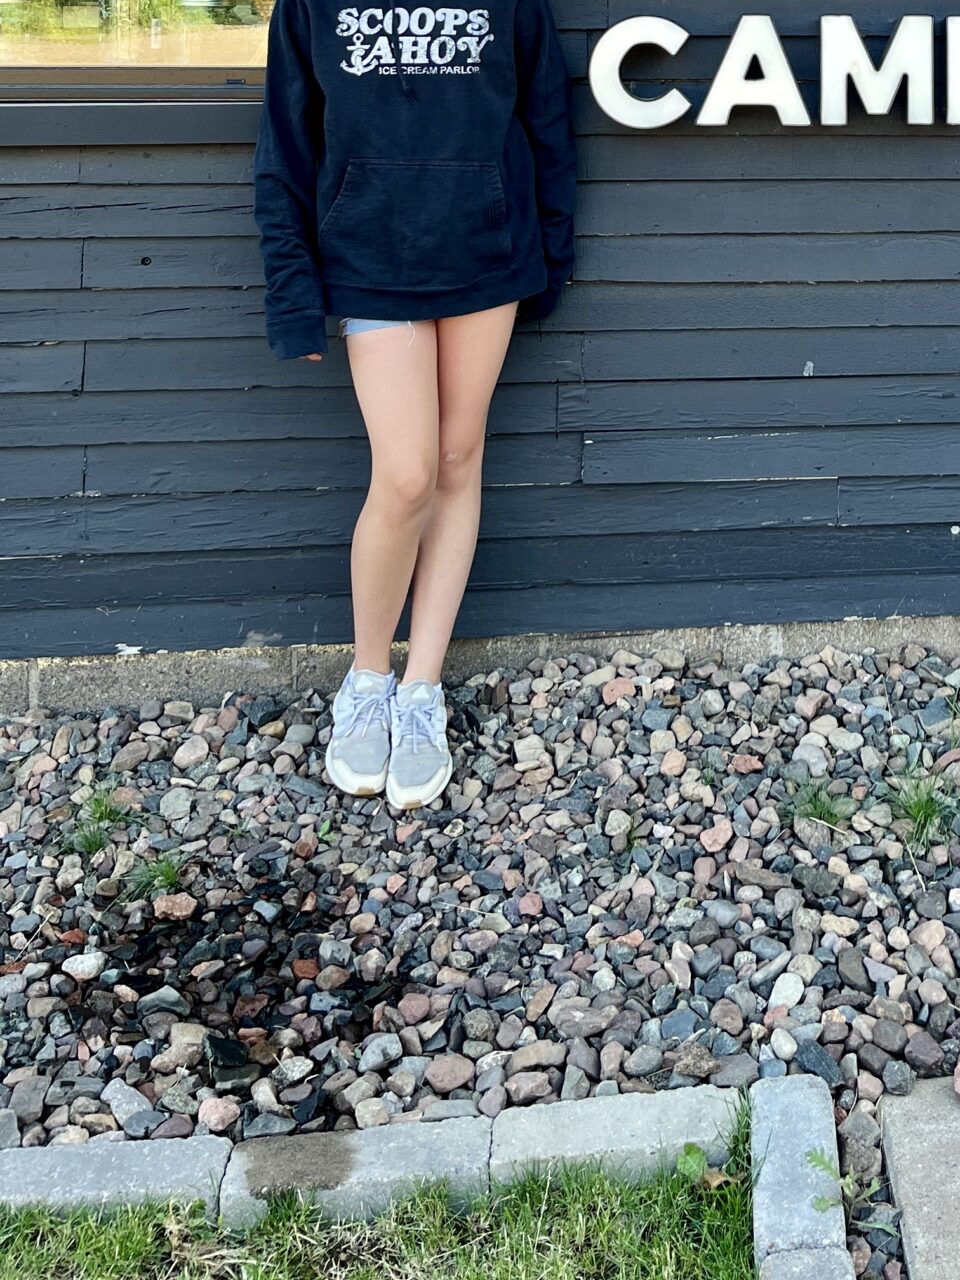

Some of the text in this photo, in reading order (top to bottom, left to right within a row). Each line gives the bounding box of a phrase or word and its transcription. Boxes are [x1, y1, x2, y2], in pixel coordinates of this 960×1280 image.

[335, 7, 490, 36] SCOOPS
[363, 34, 495, 65] AHOY
[378, 66, 398, 75] ICE
[440, 66, 480, 75] PARLOR
